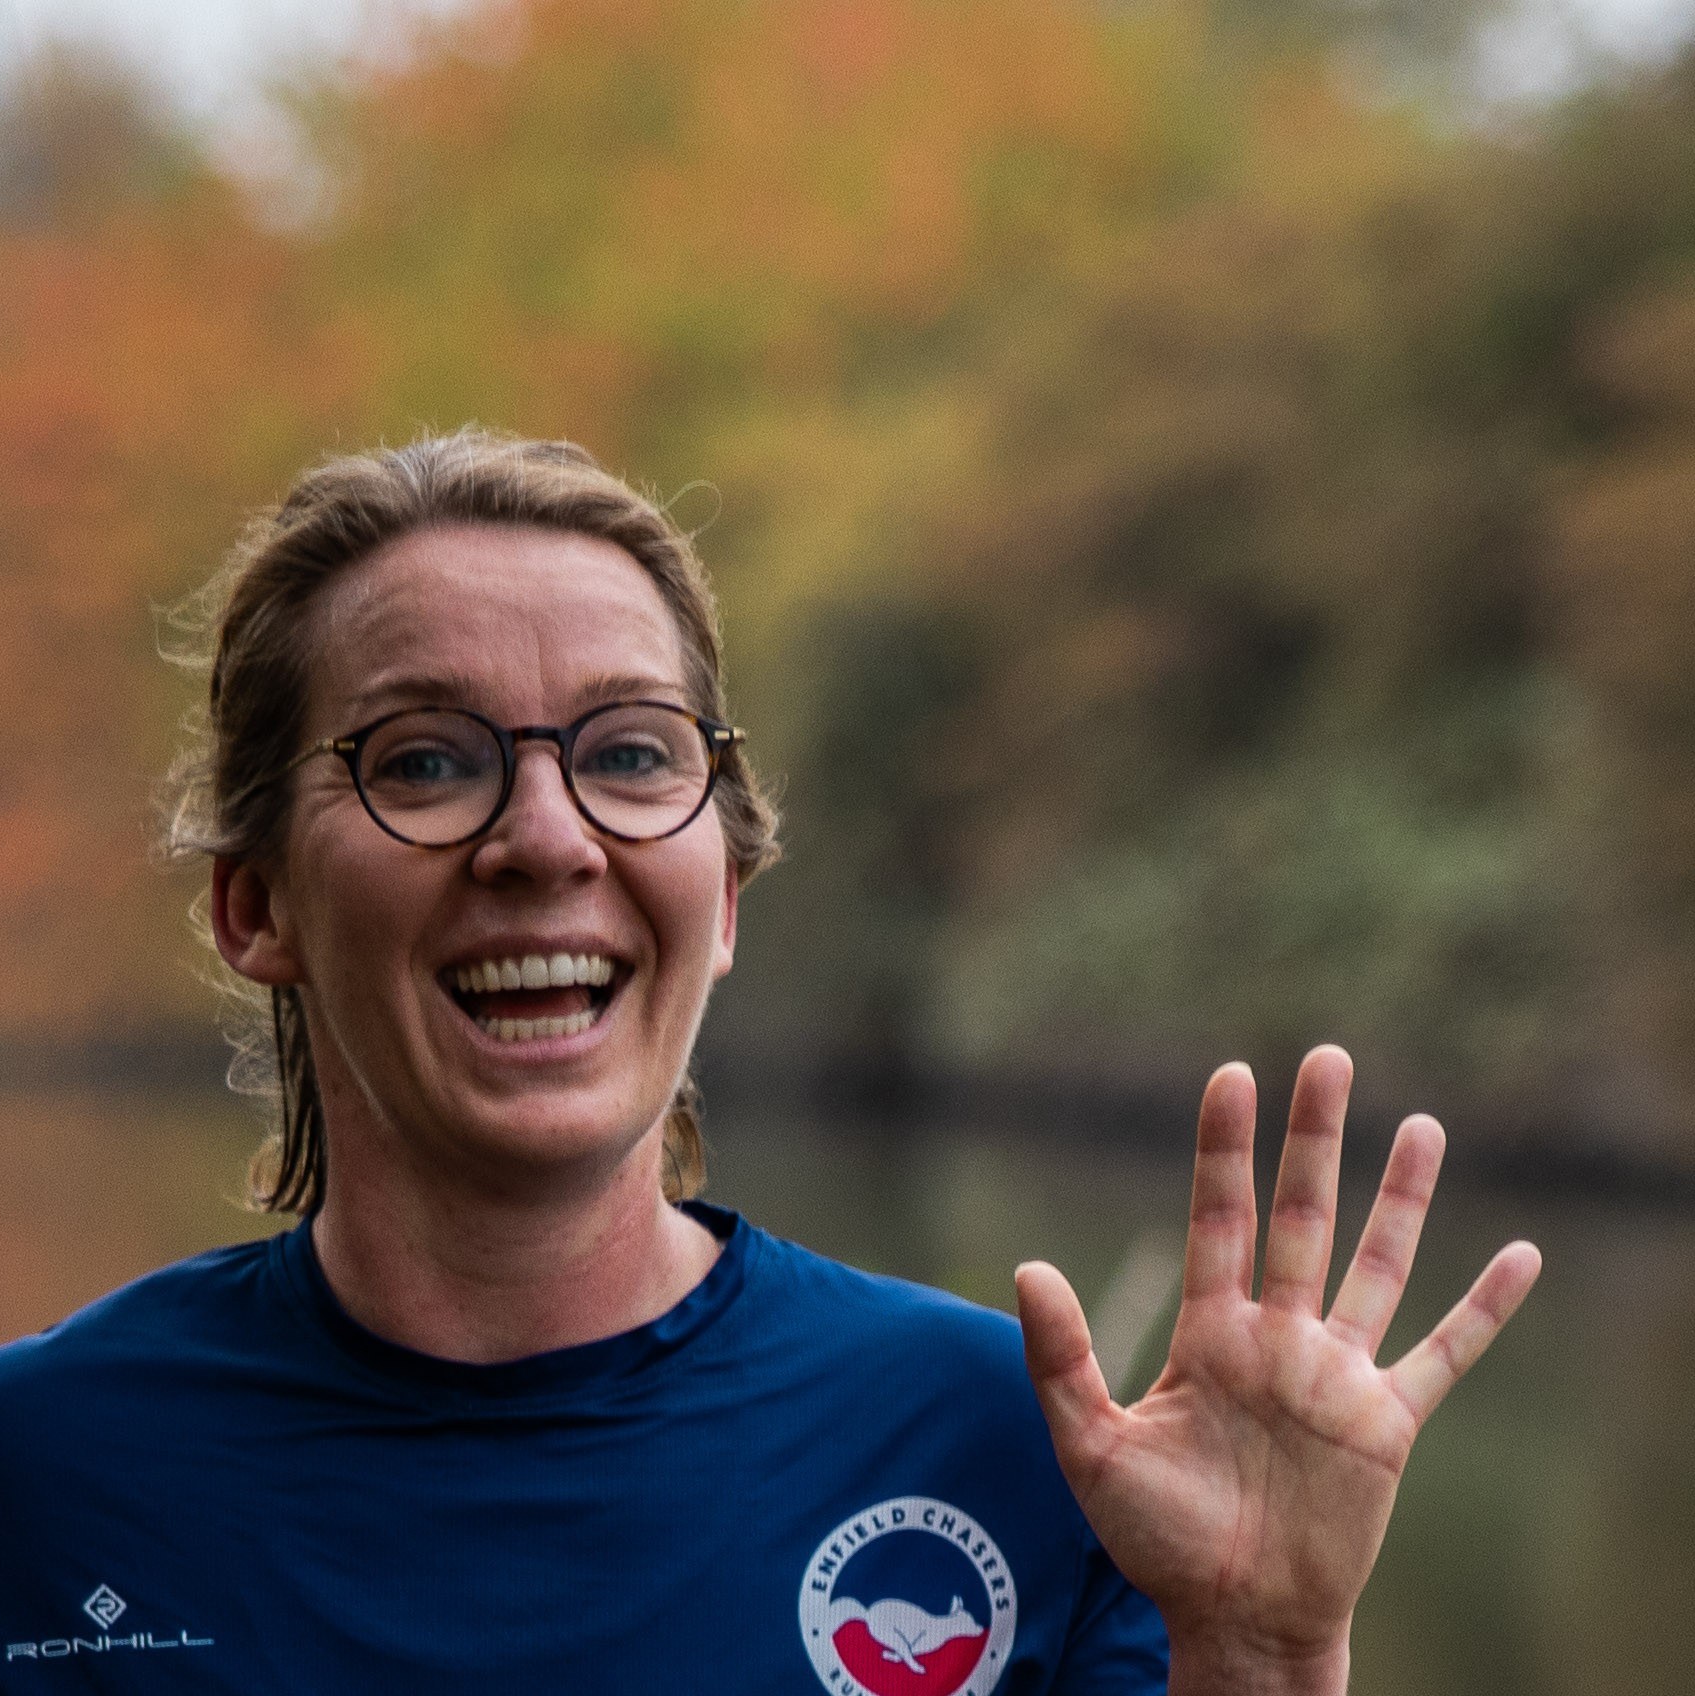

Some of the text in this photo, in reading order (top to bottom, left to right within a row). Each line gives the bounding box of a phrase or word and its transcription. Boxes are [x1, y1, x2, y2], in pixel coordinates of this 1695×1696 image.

[811, 1507, 1010, 1612] ENFIELD CHASERS
[7, 1629, 214, 1662] RONHILL
